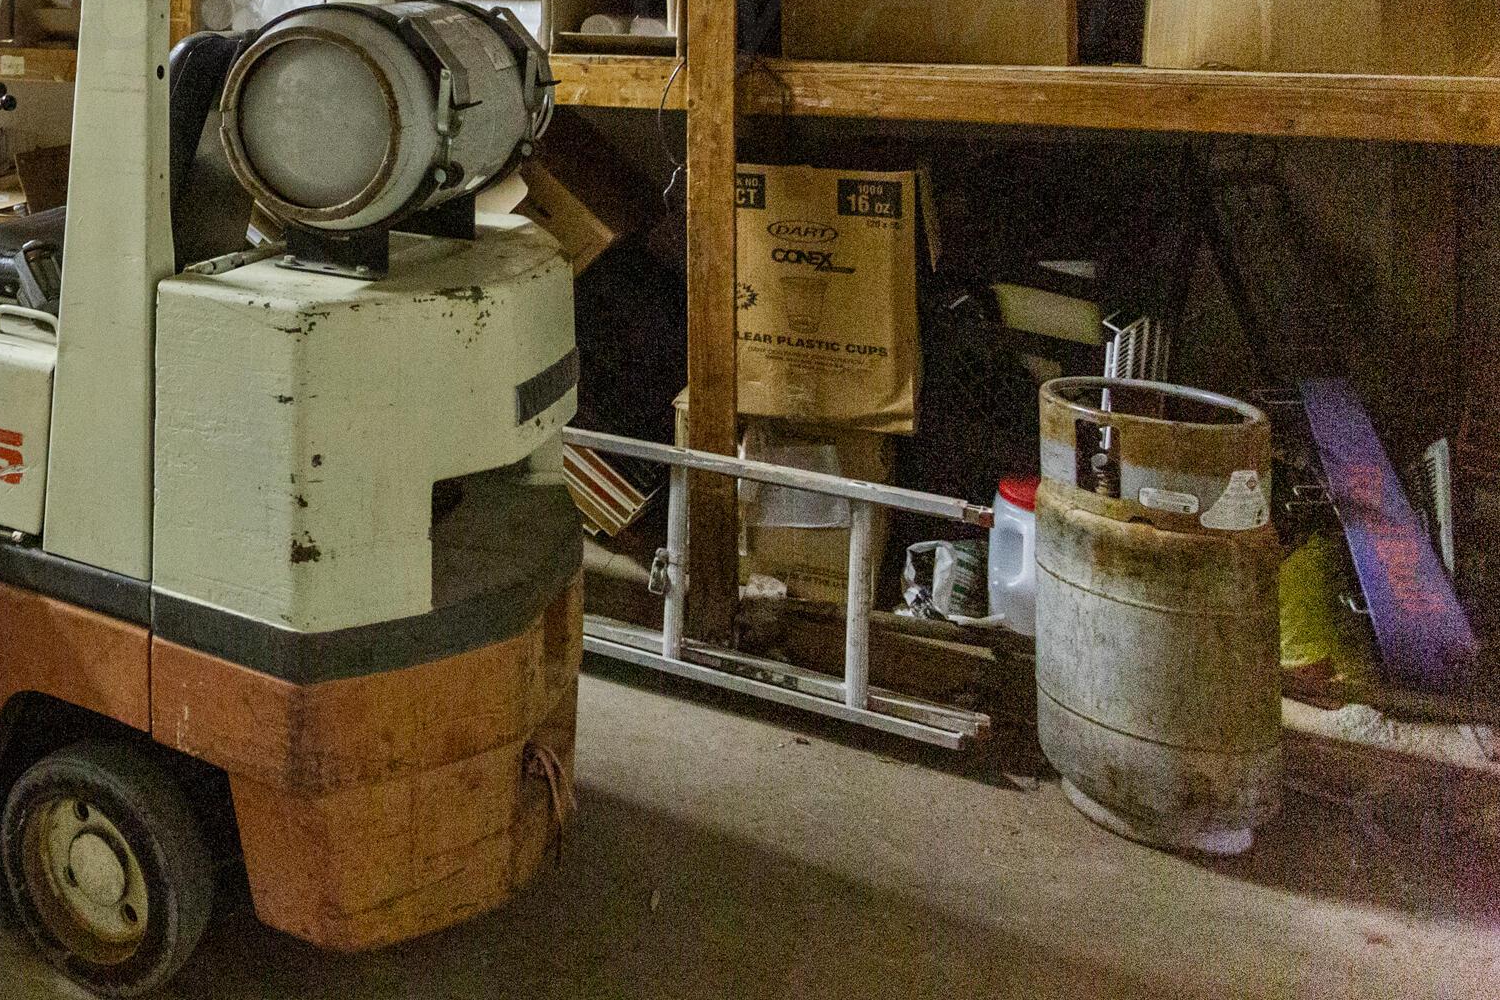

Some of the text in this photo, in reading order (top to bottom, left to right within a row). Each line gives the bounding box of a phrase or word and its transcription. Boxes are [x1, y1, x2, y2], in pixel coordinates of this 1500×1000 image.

[848, 193, 870, 214] 16
[775, 224, 830, 238] DART
[771, 247, 834, 272] CONEX
[776, 335, 841, 352] PLASTIC
[845, 344, 888, 358] CUPS
